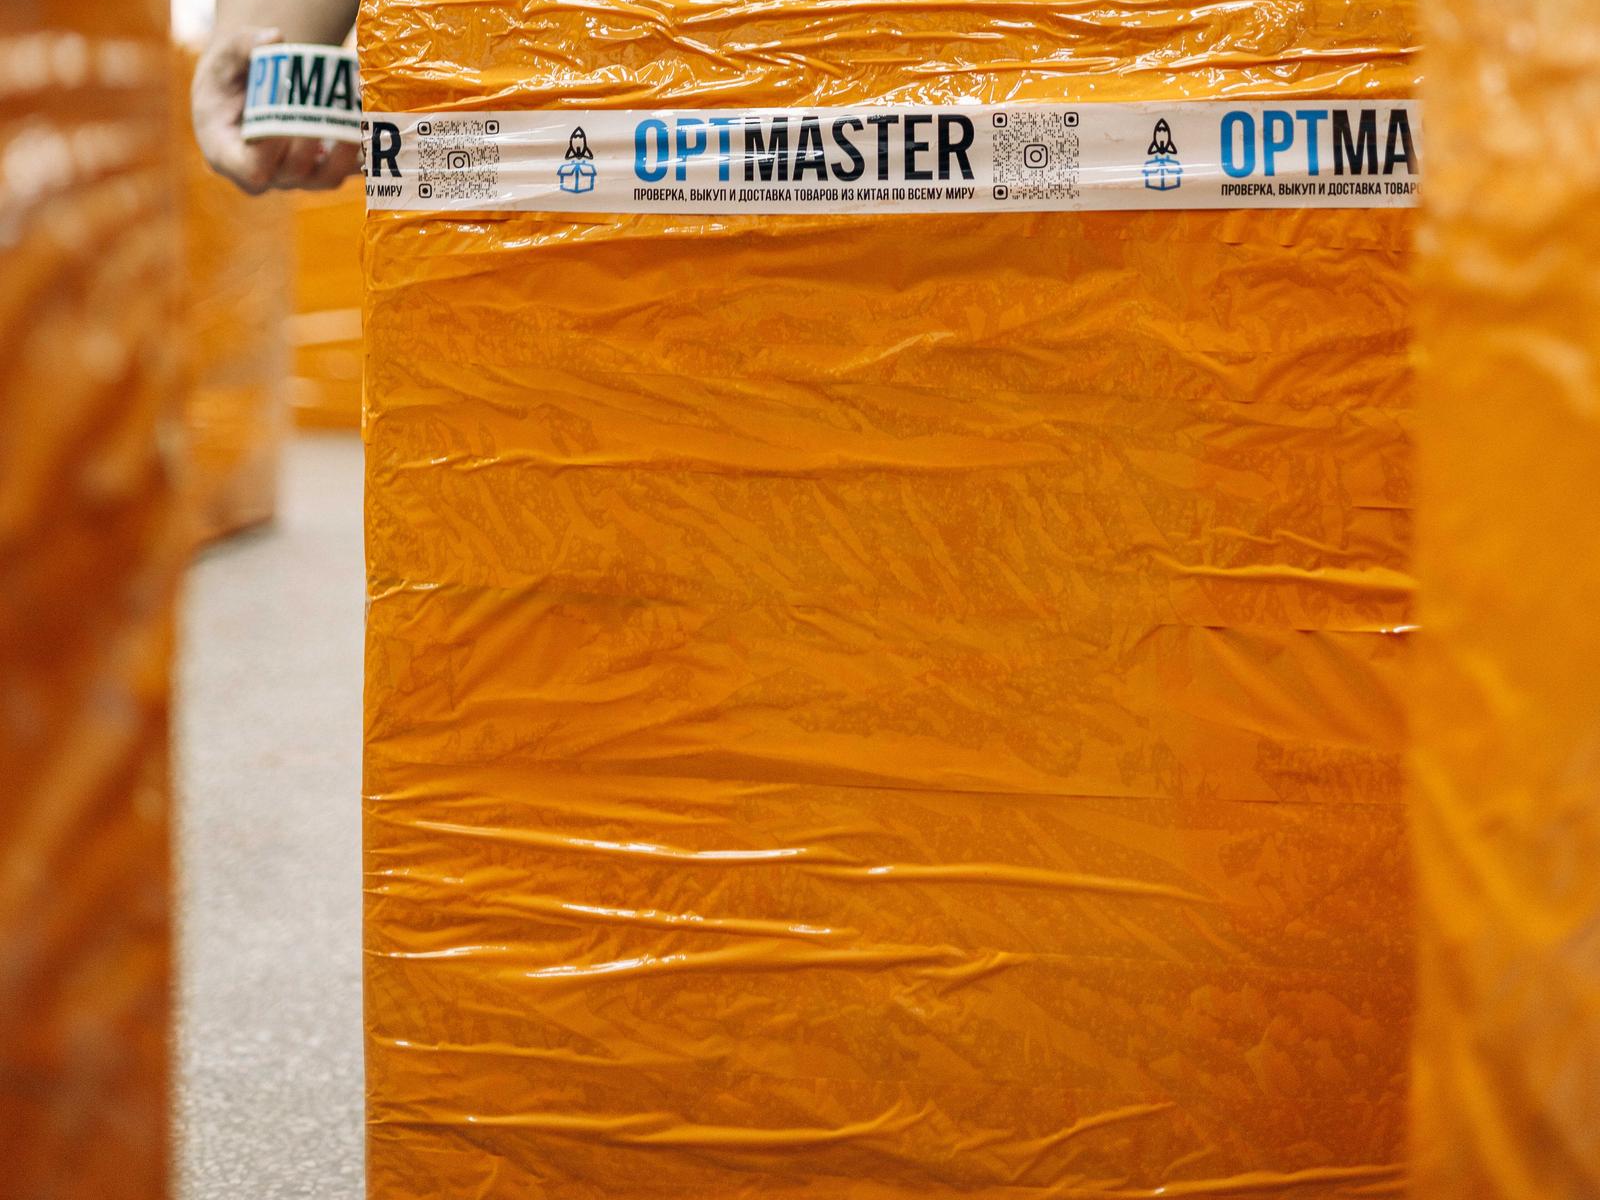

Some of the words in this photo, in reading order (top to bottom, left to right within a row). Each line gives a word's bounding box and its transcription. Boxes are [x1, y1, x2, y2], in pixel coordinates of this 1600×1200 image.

[633, 113, 976, 183] OPTMASTER
[377, 184, 403, 197] МИРУ
[633, 188, 688, 203] ПРОВЕРКА,
[689, 188, 727, 202] ВЫКУП
[729, 188, 736, 202] И
[738, 188, 792, 203] ДОСТАВКА
[794, 188, 839, 201] ТОВАРОВ
[841, 188, 854, 201] ИЗ
[857, 187, 889, 201] КИТАЯ
[891, 187, 905, 200] ПО
[908, 187, 943, 200] ВСЕМУ
[945, 186, 975, 200] МИРУ
[1221, 183, 1276, 197] ПРОВЕРКА,
[1278, 182, 1316, 196] ВЫКУП
[1318, 183, 1326, 195] И
[1327, 182, 1382, 197] ДОСТАВКА
